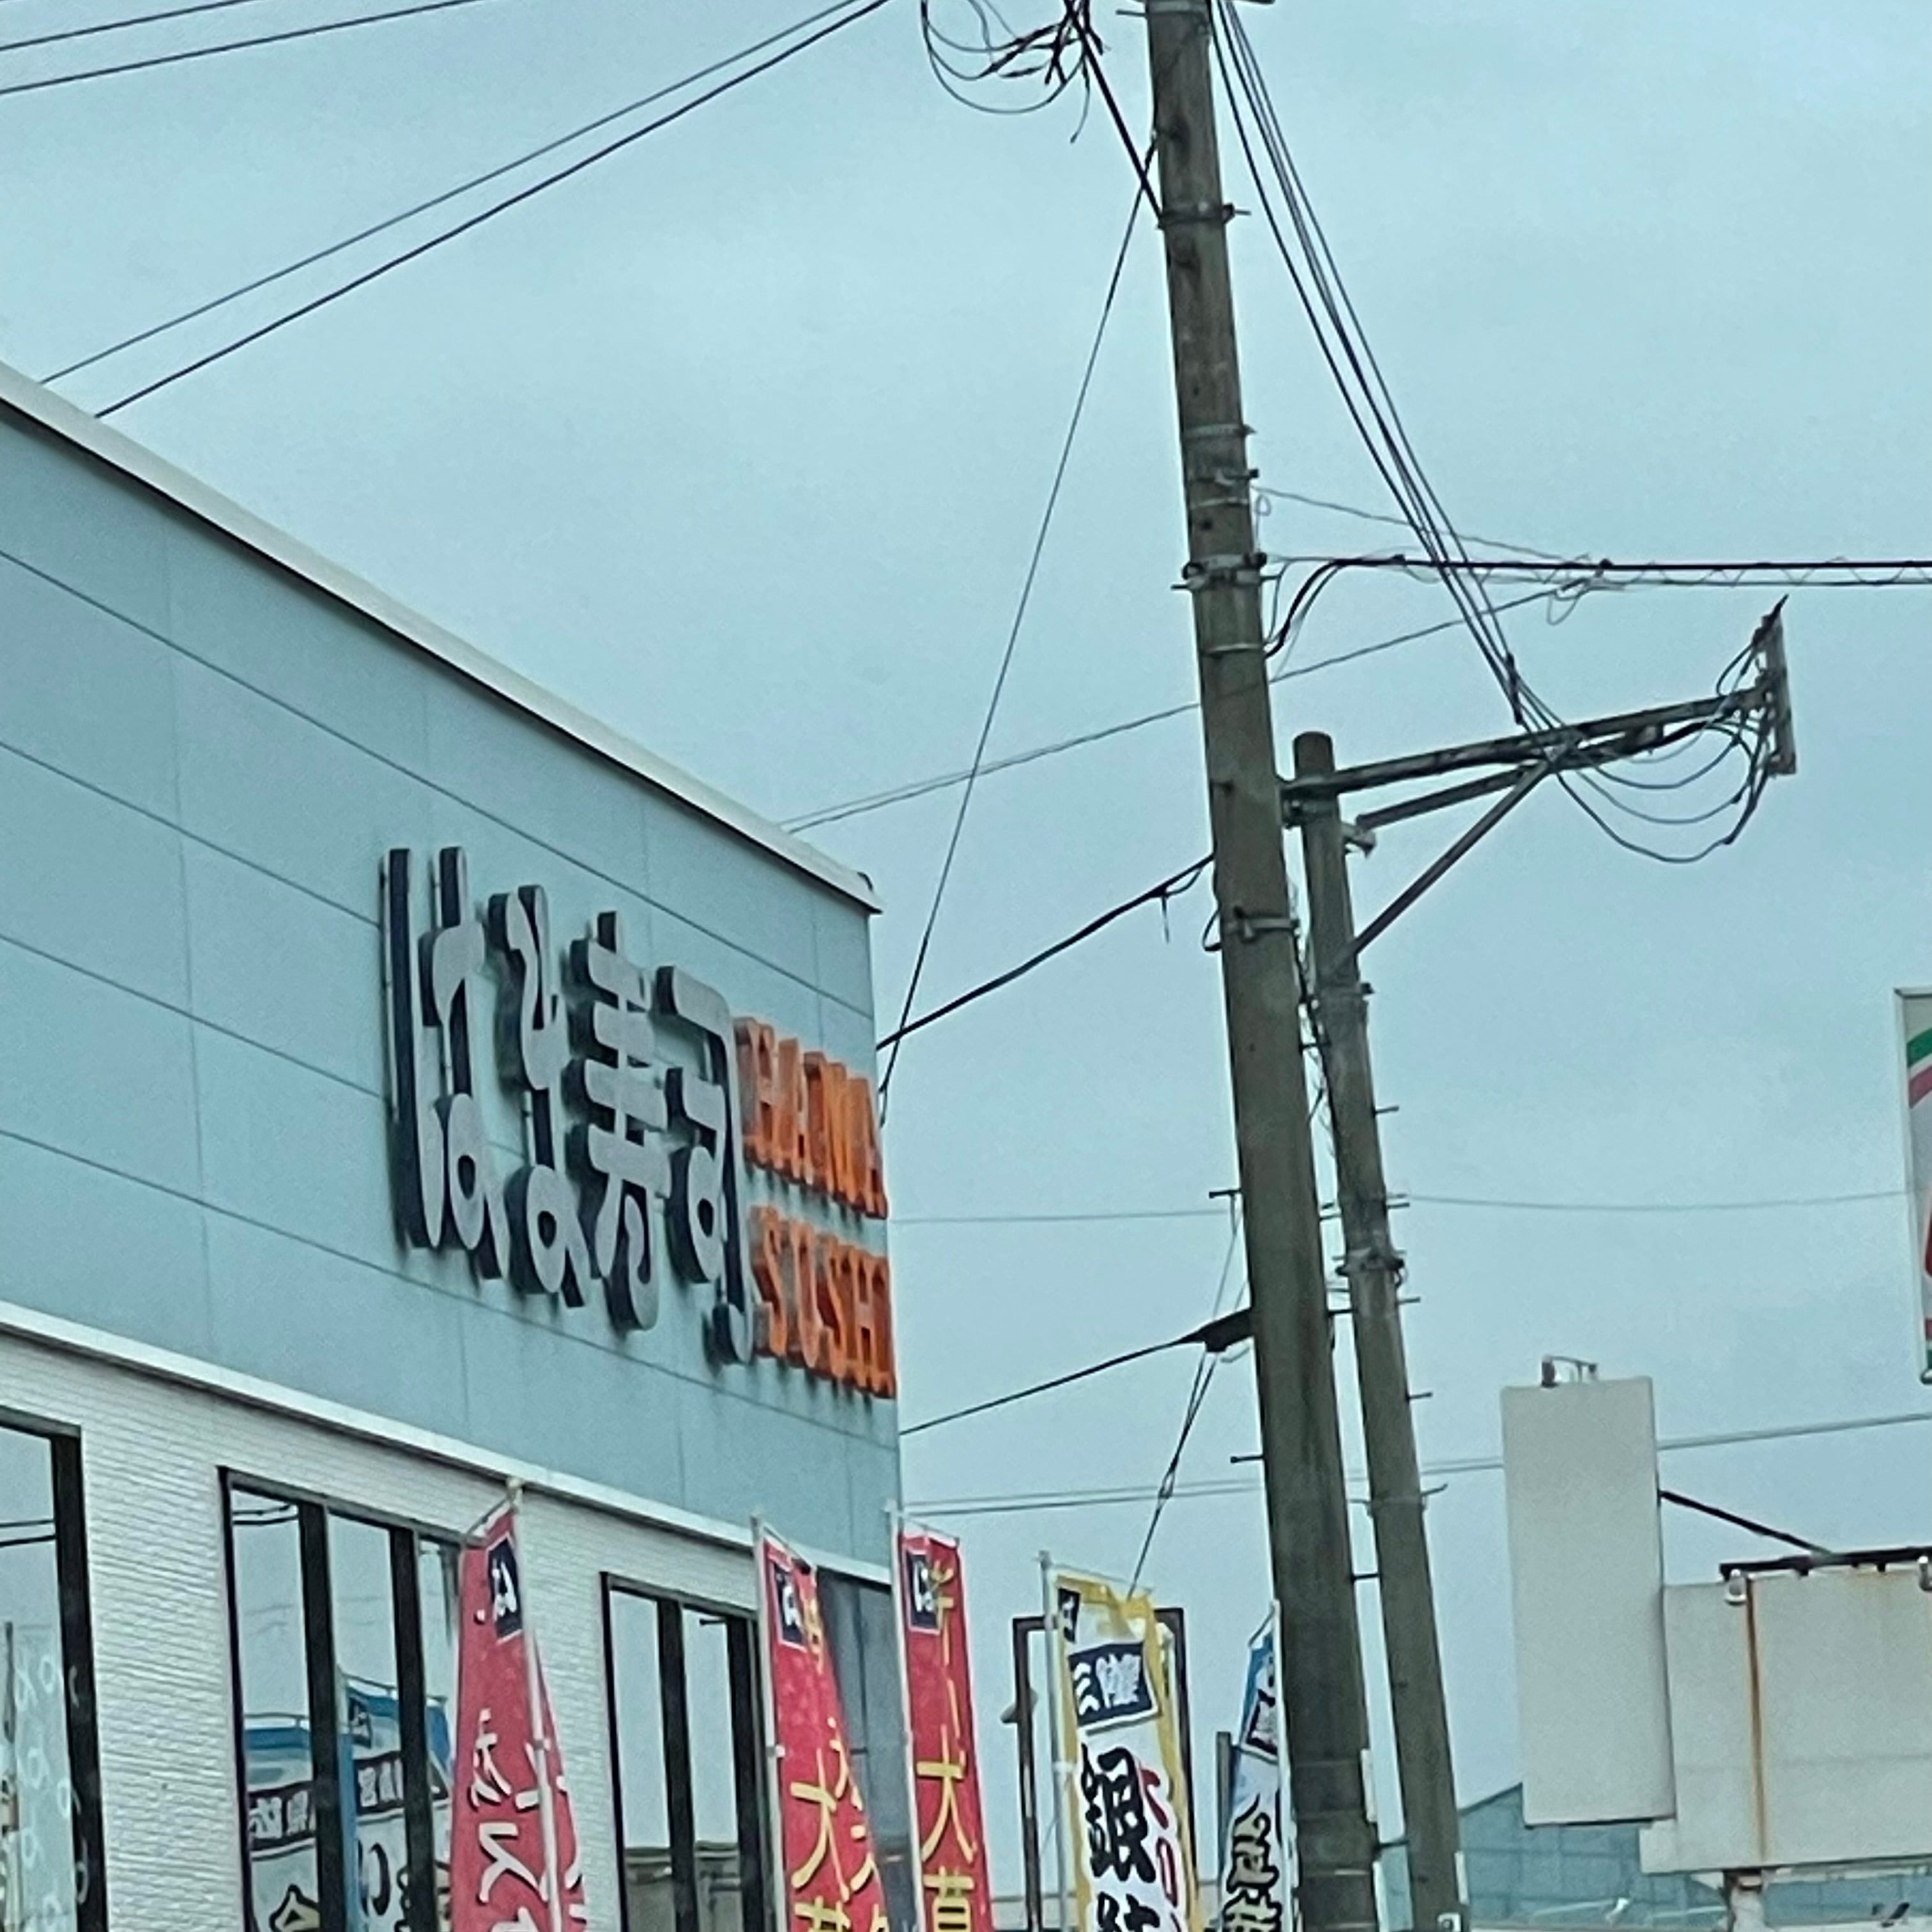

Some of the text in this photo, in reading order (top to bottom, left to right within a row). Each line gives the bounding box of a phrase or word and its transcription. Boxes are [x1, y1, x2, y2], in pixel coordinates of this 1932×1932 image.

[382, 847, 754, 1363] はま寿司
[736, 1017, 888, 1219] HAMA
